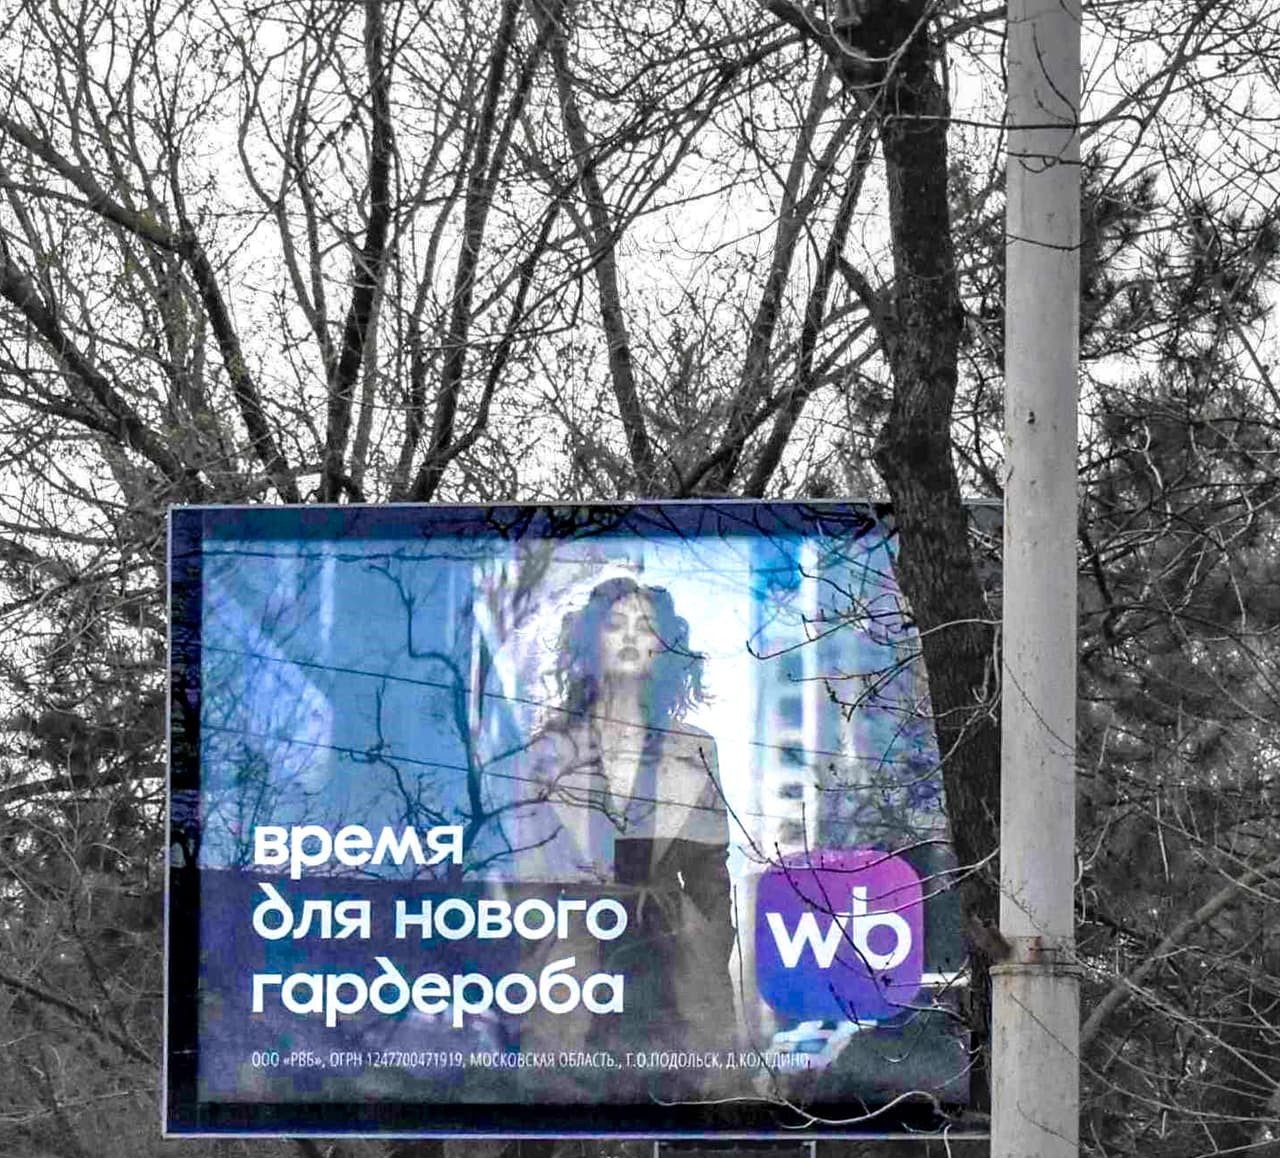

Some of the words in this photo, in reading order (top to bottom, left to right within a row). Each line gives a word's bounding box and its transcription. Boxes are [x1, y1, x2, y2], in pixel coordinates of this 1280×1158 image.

[254, 824, 464, 880] время
[252, 882, 371, 940] для
[395, 898, 628, 940] нового
[765, 886, 913, 970] wb
[252, 956, 625, 1028] гардероба
[251, 1051, 280, 1068] ООО
[329, 1051, 363, 1068] ОГРН
[366, 1051, 465, 1070] 1247700471919,
[470, 1051, 555, 1068] МОСКОВСКАЯ
